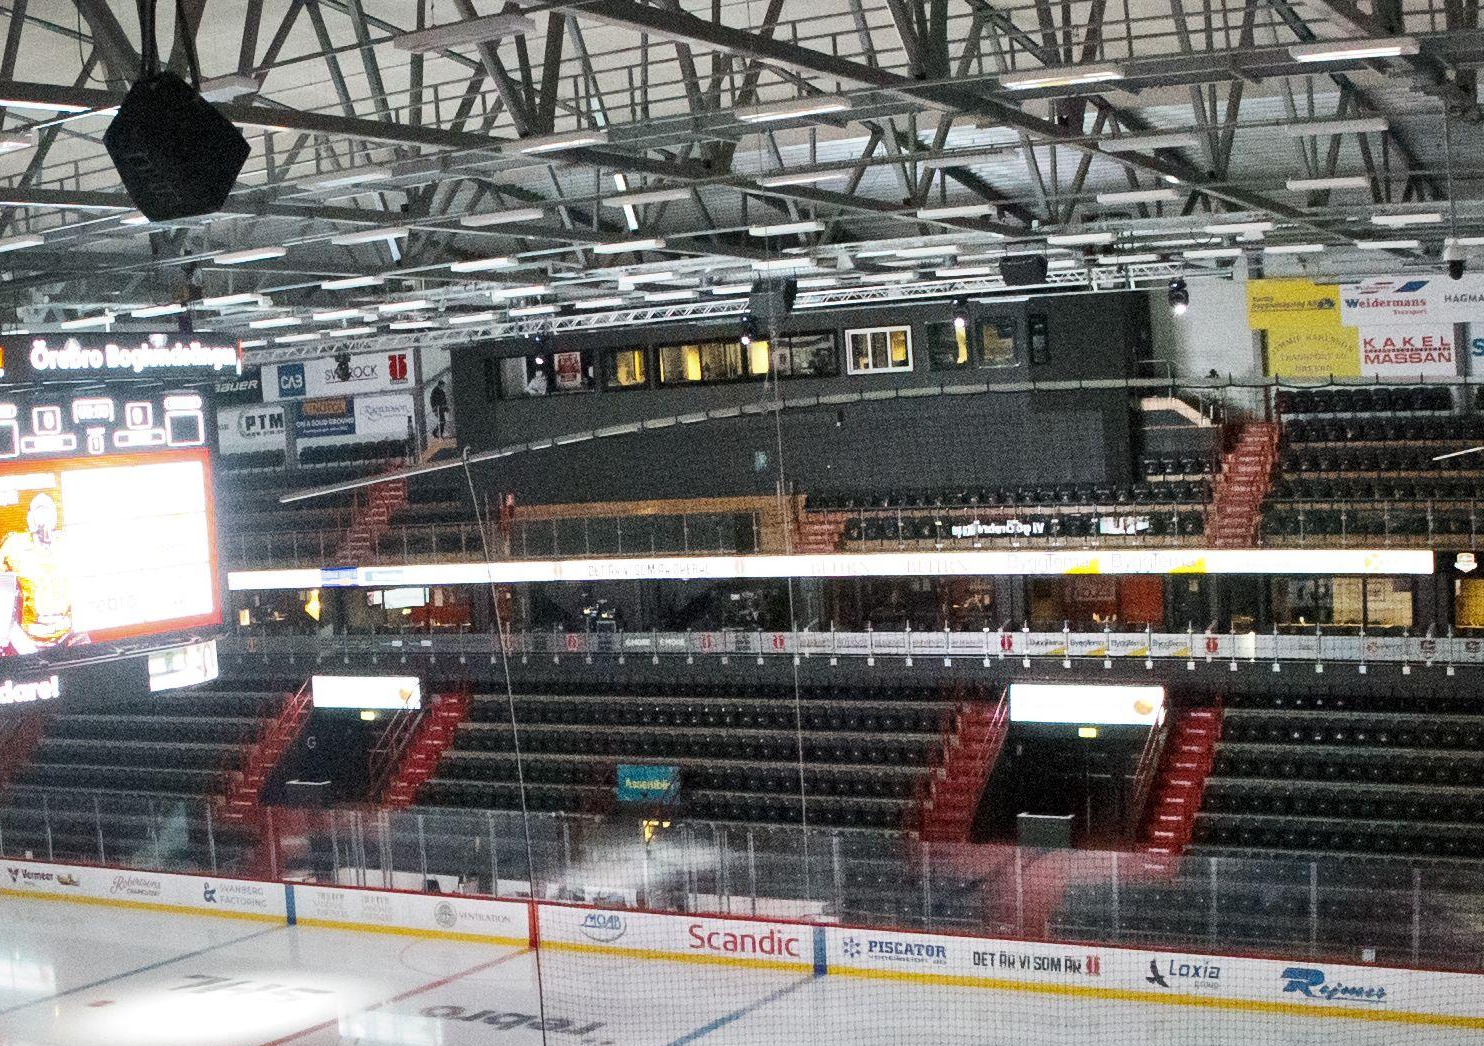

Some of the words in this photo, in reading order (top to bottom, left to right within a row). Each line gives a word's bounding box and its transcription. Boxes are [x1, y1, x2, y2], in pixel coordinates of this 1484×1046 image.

[1363, 335, 1452, 349] KAKEL
[1364, 352, 1452, 365] MASSAN
[324, 364, 378, 382] SWROCK
[244, 412, 284, 431] PTM
[688, 923, 800, 958] Scandic
[868, 939, 947, 960] PISCATOR
[972, 951, 995, 967] DET
[999, 950, 1016, 967] ÄR
[1019, 952, 1030, 969] VI
[1033, 954, 1061, 972] SOM
[1064, 956, 1082, 973] ÄR
[1281, 966, 1387, 1000] Rejmes
[419, 1004, 607, 1036] rebro
